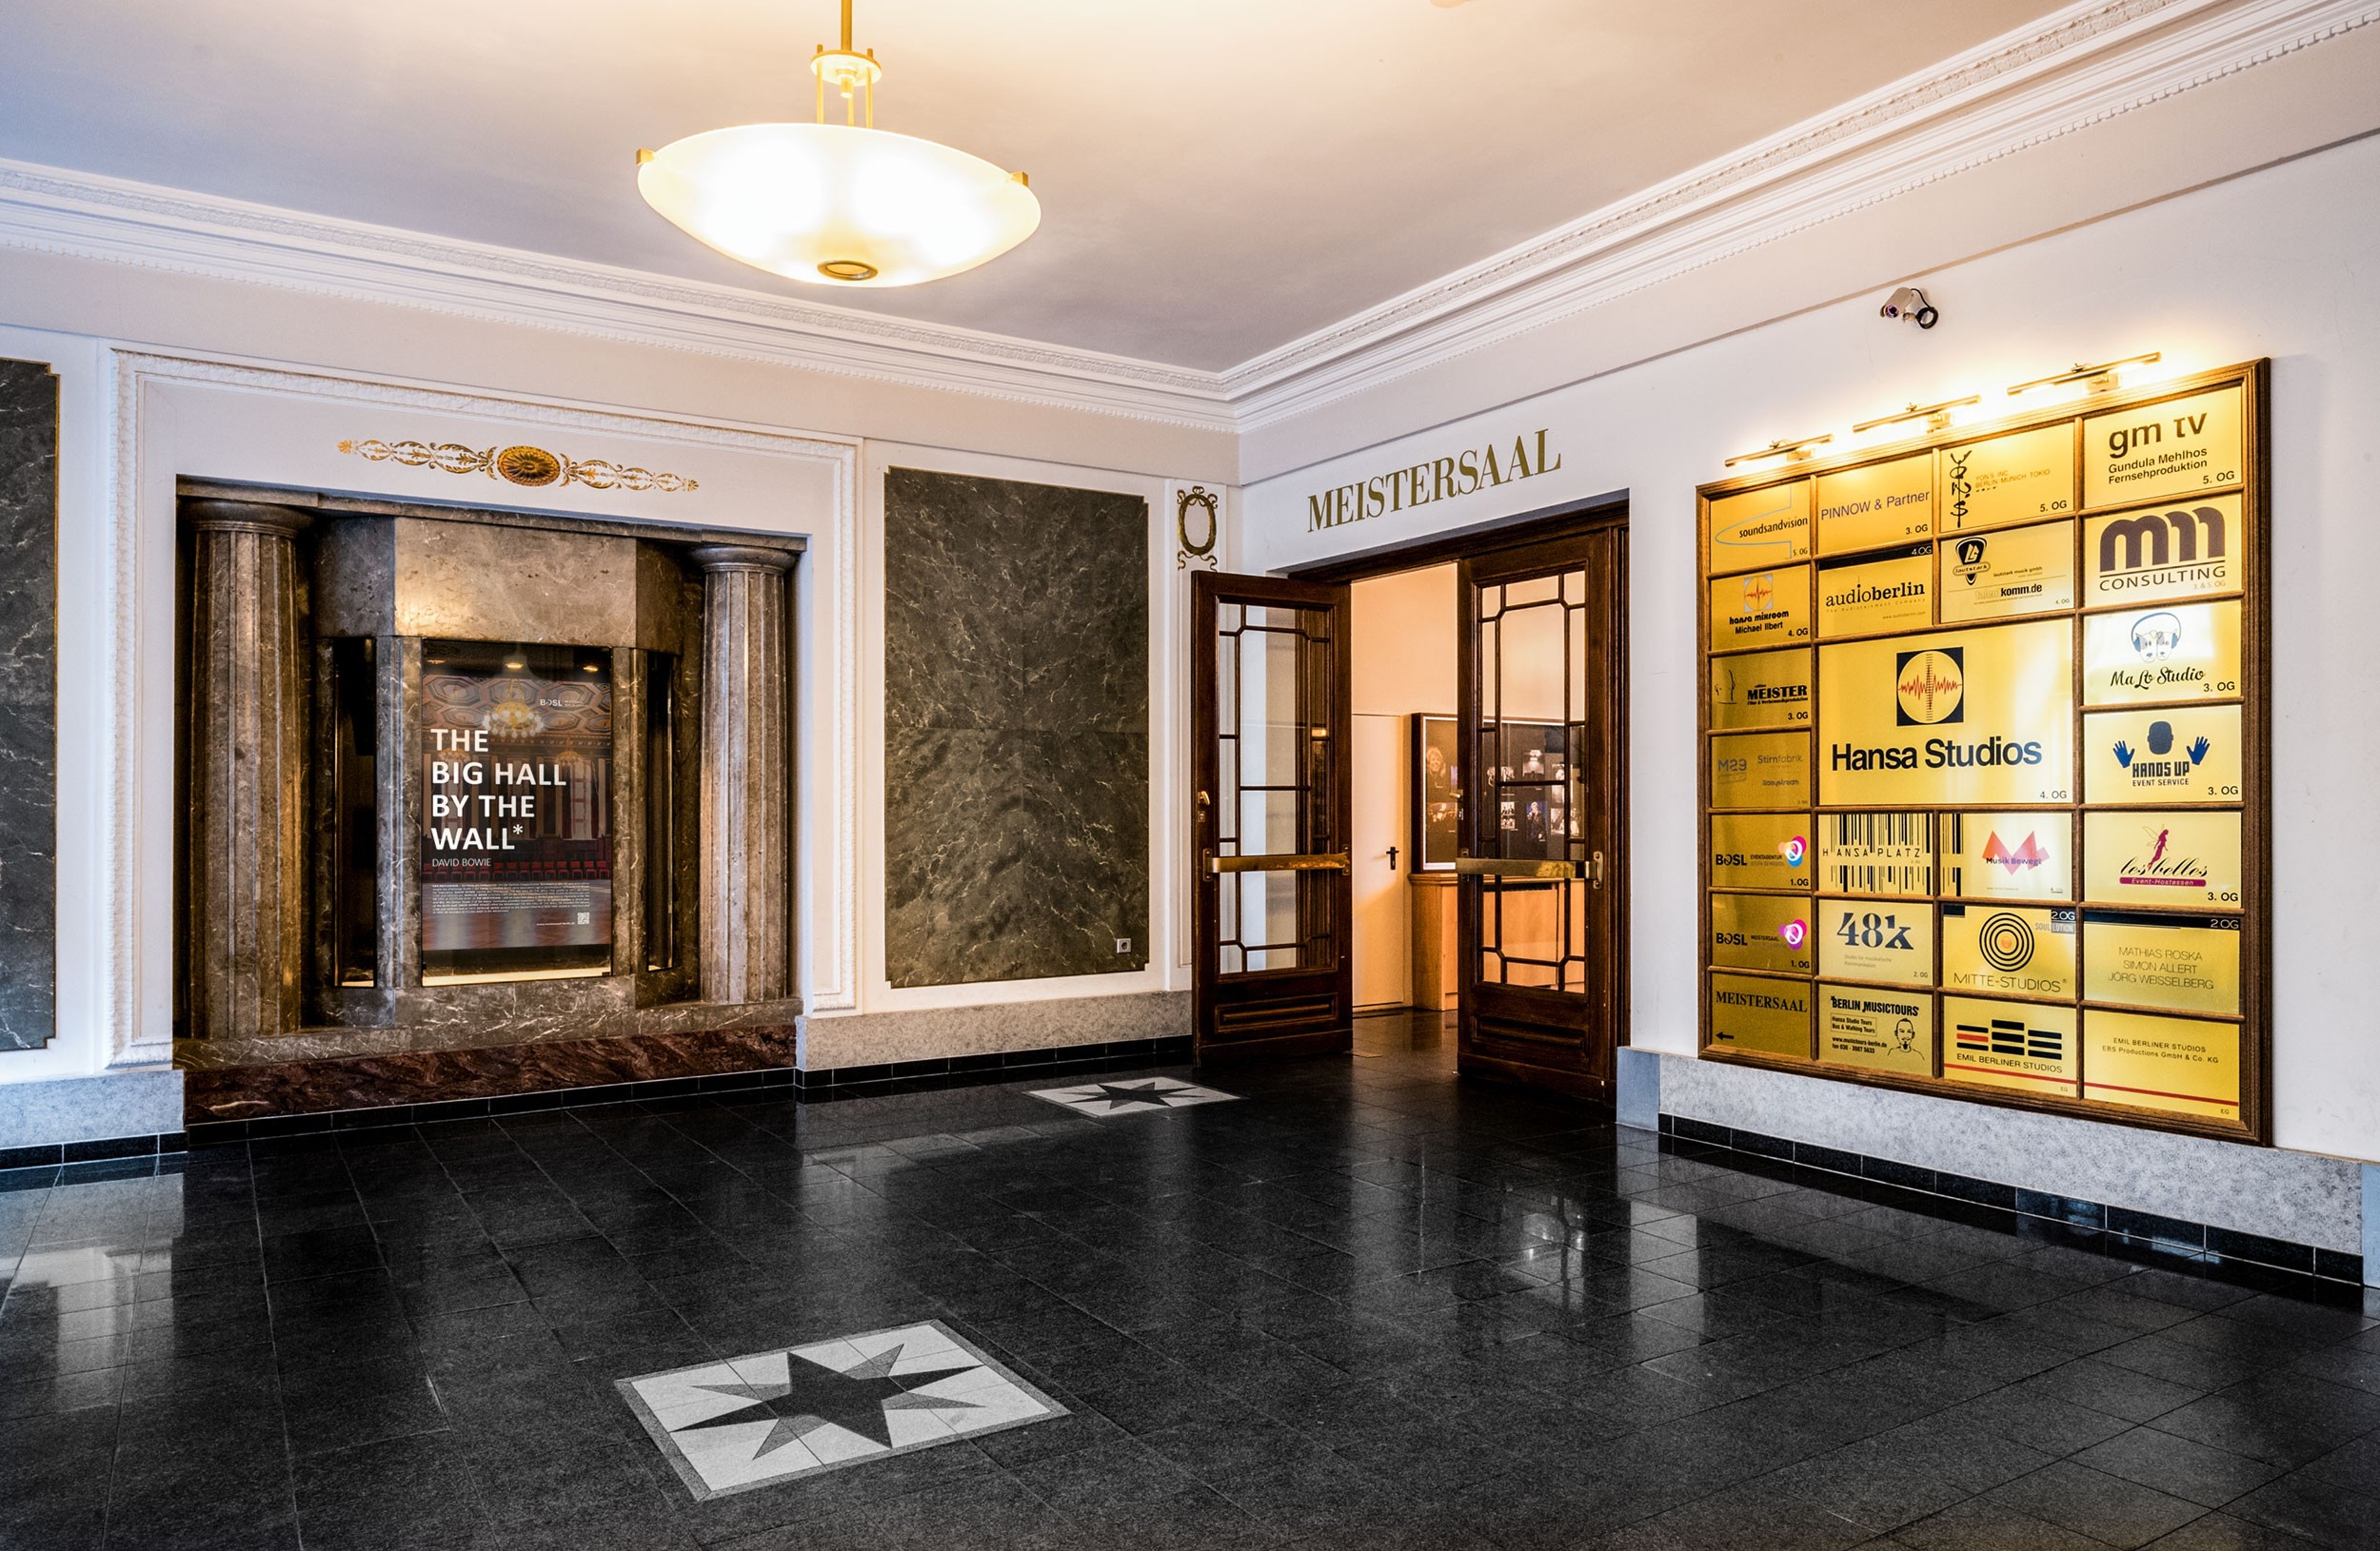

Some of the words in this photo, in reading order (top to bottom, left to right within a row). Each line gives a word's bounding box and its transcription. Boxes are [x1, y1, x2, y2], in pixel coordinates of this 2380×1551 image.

[2109, 423, 2162, 459] gm
[2108, 457, 2156, 474] Gundula
[2158, 447, 2208, 465] Mehlhos
[1307, 428, 1561, 533] MEISTERSAAL
[1975, 478, 1998, 489] BERLIN
[2030, 468, 2051, 478] TOKIO
[2108, 460, 2208, 485] Fernsehproduktion
[2203, 475, 2213, 485] 5.
[2216, 470, 2235, 483] OG
[1821, 501, 1871, 521] PINNOW
[1874, 499, 1882, 510] &
[1887, 491, 1930, 507] Partner
[2040, 503, 2048, 512] 5.
[2051, 500, 2068, 511] OG
[1739, 516, 1809, 538] soundsandvision
[1905, 526, 1913, 535] 3.
[1915, 524, 1928, 534] OG
[2099, 565, 2226, 591] CONSULTING
[1826, 581, 1925, 607] audioberlin
[1729, 616, 1752, 625] hansa
[1754, 610, 1789, 621] mixroom
[1735, 623, 1762, 634] Michael
[1796, 628, 1809, 636] OG
[2157, 666, 2206, 685] Studio
[1747, 685, 1808, 700] MEISTER
[2203, 683, 2213, 692] 3.
[2217, 681, 2236, 692] OG
[1796, 711, 1809, 719] OG
[430, 728, 489, 752] THE
[1833, 743, 1918, 771] Hansa
[1924, 735, 2042, 769] Studios
[432, 762, 483, 785] BIG
[495, 762, 567, 786] HALL
[2132, 762, 2171, 778] HANDS
[2174, 760, 2190, 777] UP
[2132, 779, 2155, 787] EVENT
[2157, 778, 2190, 786] SERVICE
[2208, 786, 2218, 796] 3.
[2221, 785, 2239, 795] OG
[2039, 791, 2048, 799] 4.
[2051, 790, 2067, 799] OG
[432, 794, 469, 817] BY
[478, 795, 535, 818] THE
[432, 858, 460, 867] DAVID
[462, 858, 492, 867] BOWIE
[2120, 856, 2146, 876] les
[2152, 856, 2208, 877] belles
[2131, 877, 2194, 886] Event-Hostessen
[2207, 892, 2217, 901] 3.
[2221, 892, 2239, 902] OG
[2118, 946, 2162, 959] MATHIAS
[2165, 949, 2203, 961] ROSKA
[1798, 960, 1810, 969] OG
[2123, 960, 2157, 972] SIMON
[2159, 962, 2198, 975] ALLERT
[1954, 972, 2061, 993] MITTE-STUDIOS
[2139, 974, 2214, 990] WEISSELBERG
[1716, 991, 1808, 1013] MEISTERSAAL
[1832, 998, 1861, 1011] BERLIN
[1862, 1001, 1920, 1017] MUSICTOURS
[2113, 1037, 2130, 1045] EMIL
[2132, 1039, 2170, 1049] BERLINER
[2172, 1043, 2206, 1053] STUDIOS
[1957, 1053, 1977, 1062] EMIL
[1978, 1055, 2021, 1068] BERLINER
[2023, 1061, 2063, 1073] STUDIOS
[2118, 1047, 2159, 1057] Productions
[2161, 1051, 2183, 1060] GmbH
[2207, 1056, 2219, 1064] KG
